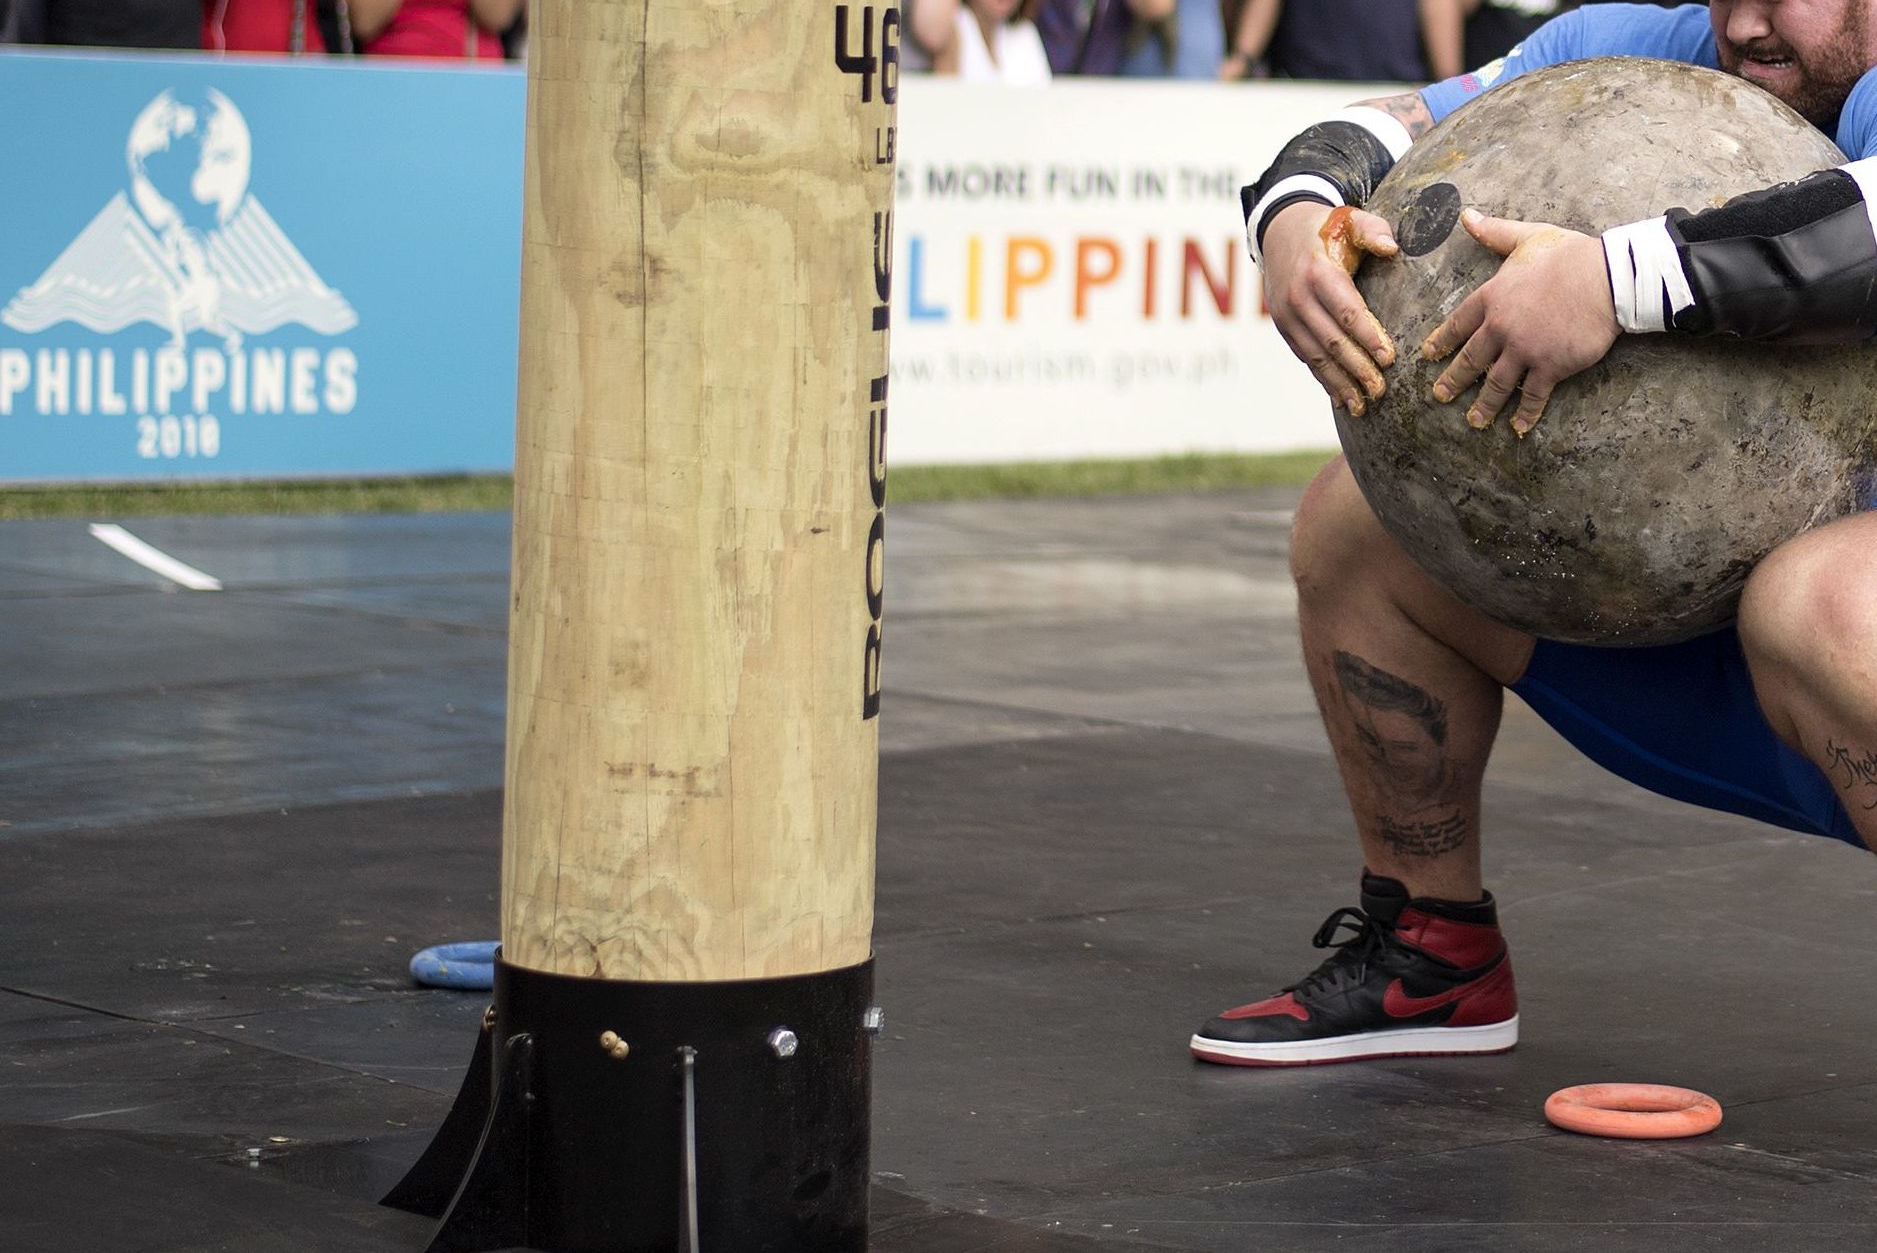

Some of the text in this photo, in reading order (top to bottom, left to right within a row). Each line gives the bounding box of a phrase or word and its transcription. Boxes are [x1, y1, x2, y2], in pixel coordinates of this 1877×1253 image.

[835, 5, 900, 105] 46
[876, 127, 897, 164] LB
[924, 162, 1029, 199] MORE
[1048, 162, 1119, 199] FUN
[1134, 163, 1167, 199] IN
[1181, 162, 1240, 199] THE
[906, 236, 1275, 322] LIPPIN
[0, 347, 358, 415] PHILIPPINES
